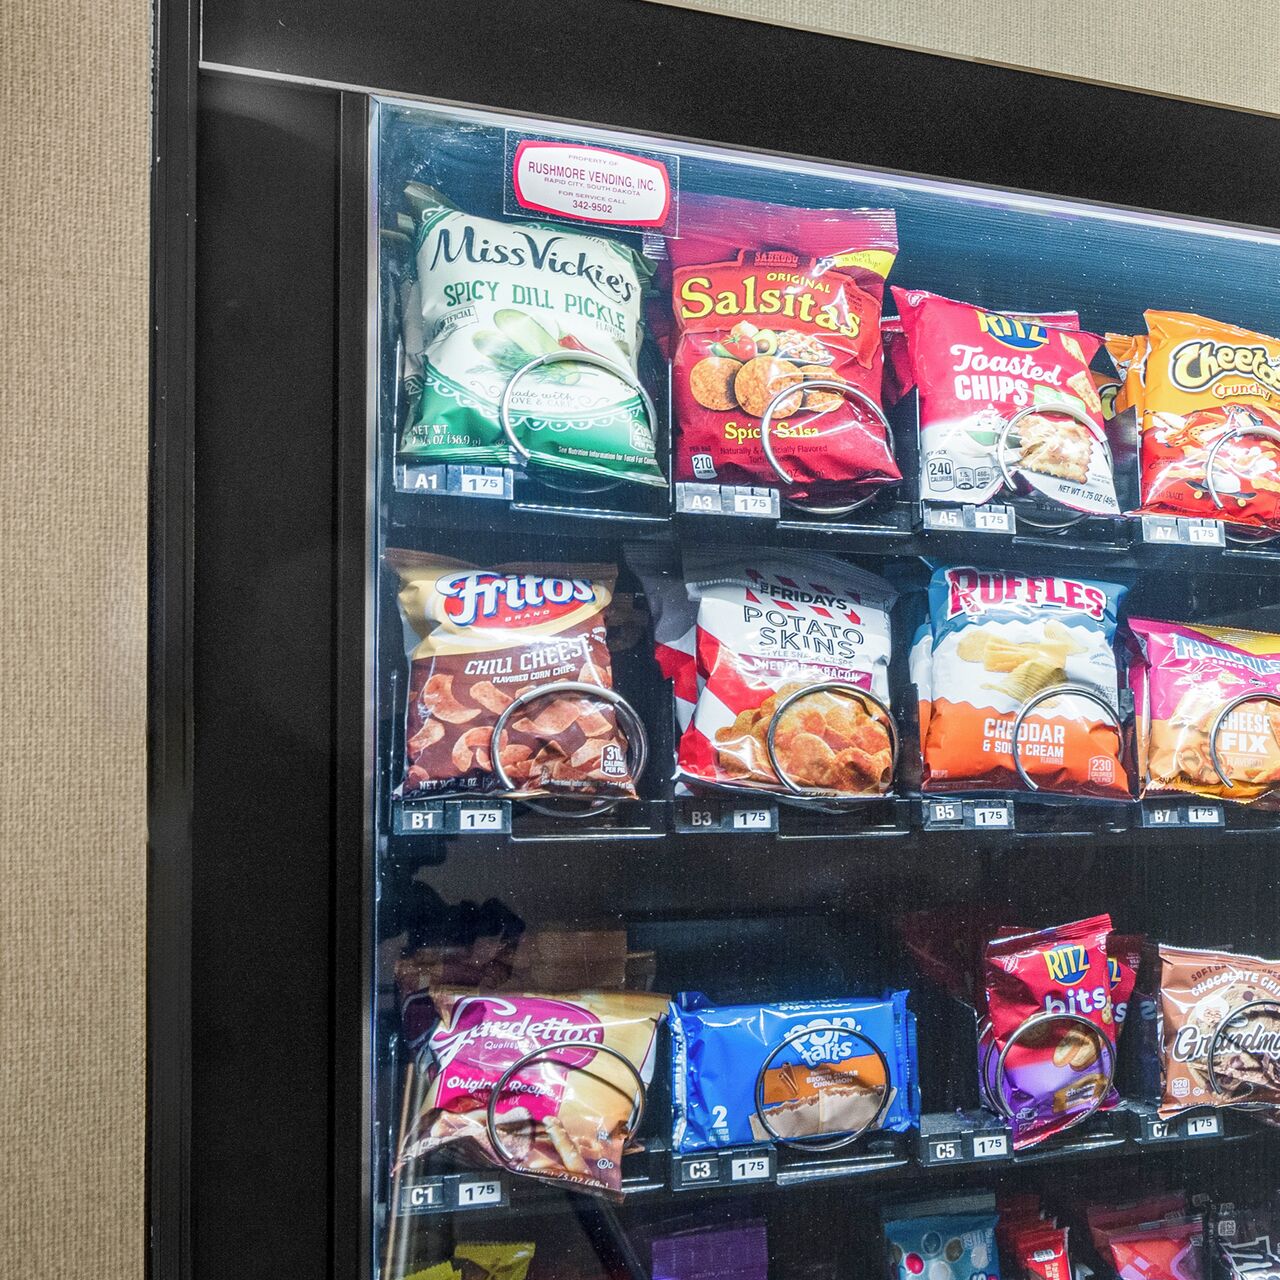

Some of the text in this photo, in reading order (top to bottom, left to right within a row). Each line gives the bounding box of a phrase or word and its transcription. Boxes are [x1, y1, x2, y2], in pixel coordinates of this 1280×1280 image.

[568, 154, 607, 165] PROPERTY
[528, 161, 657, 191] RUSHMORE VENDING, INC.
[544, 177, 566, 185] RAPID
[587, 183, 611, 192] SOUTH
[612, 186, 641, 196] DAKOTA
[572, 200, 613, 213] 342-9502
[575, 192, 606, 202] SERVICE
[607, 197, 627, 205] CALL
[429, 225, 638, 304] Miss Vickie's
[766, 272, 832, 294] ORIGINAL
[443, 279, 626, 333] SPICY DILL PICKLE
[680, 276, 862, 338] Salsitas
[950, 344, 1063, 386] Toasted
[954, 374, 1030, 407] CHIPS
[1211, 381, 1273, 401] Crunchy
[776, 421, 819, 438] Salsa
[693, 457, 711, 470] 210
[930, 463, 952, 476] 240
[414, 473, 438, 488] A1
[691, 496, 713, 509] A3
[939, 511, 957, 525] A5
[1155, 526, 1173, 540] A7
[435, 570, 596, 627] Fritos
[769, 584, 848, 610] FRIDAYS
[948, 568, 1106, 618] RUFFLES
[504, 609, 551, 623] BRAND
[743, 605, 864, 646] POTATO
[758, 627, 856, 659] SKINS
[464, 657, 513, 675] CHILI
[492, 664, 576, 684] FLAVORED CORN CHIPS
[1222, 713, 1270, 730] CHEESE
[983, 717, 1066, 745] CHEDDAR
[982, 740, 1064, 758] & CREAM
[1221, 732, 1269, 755] FIX
[1092, 759, 1112, 772] 230
[691, 811, 712, 826] B3
[935, 805, 955, 819] B5
[1154, 810, 1170, 822] B7
[411, 814, 434, 829] B1
[1043, 945, 1091, 980] RITZ
[1191, 966, 1213, 983] SOFT
[1191, 971, 1258, 997] CHOCOLATE
[1045, 986, 1107, 1015] bits
[801, 1039, 852, 1067] tarts
[712, 1105, 728, 1128] 2
[1152, 1123, 1169, 1138] C7
[936, 1143, 956, 1158] C5
[689, 1162, 711, 1178] C3
[411, 1188, 435, 1204] C1
